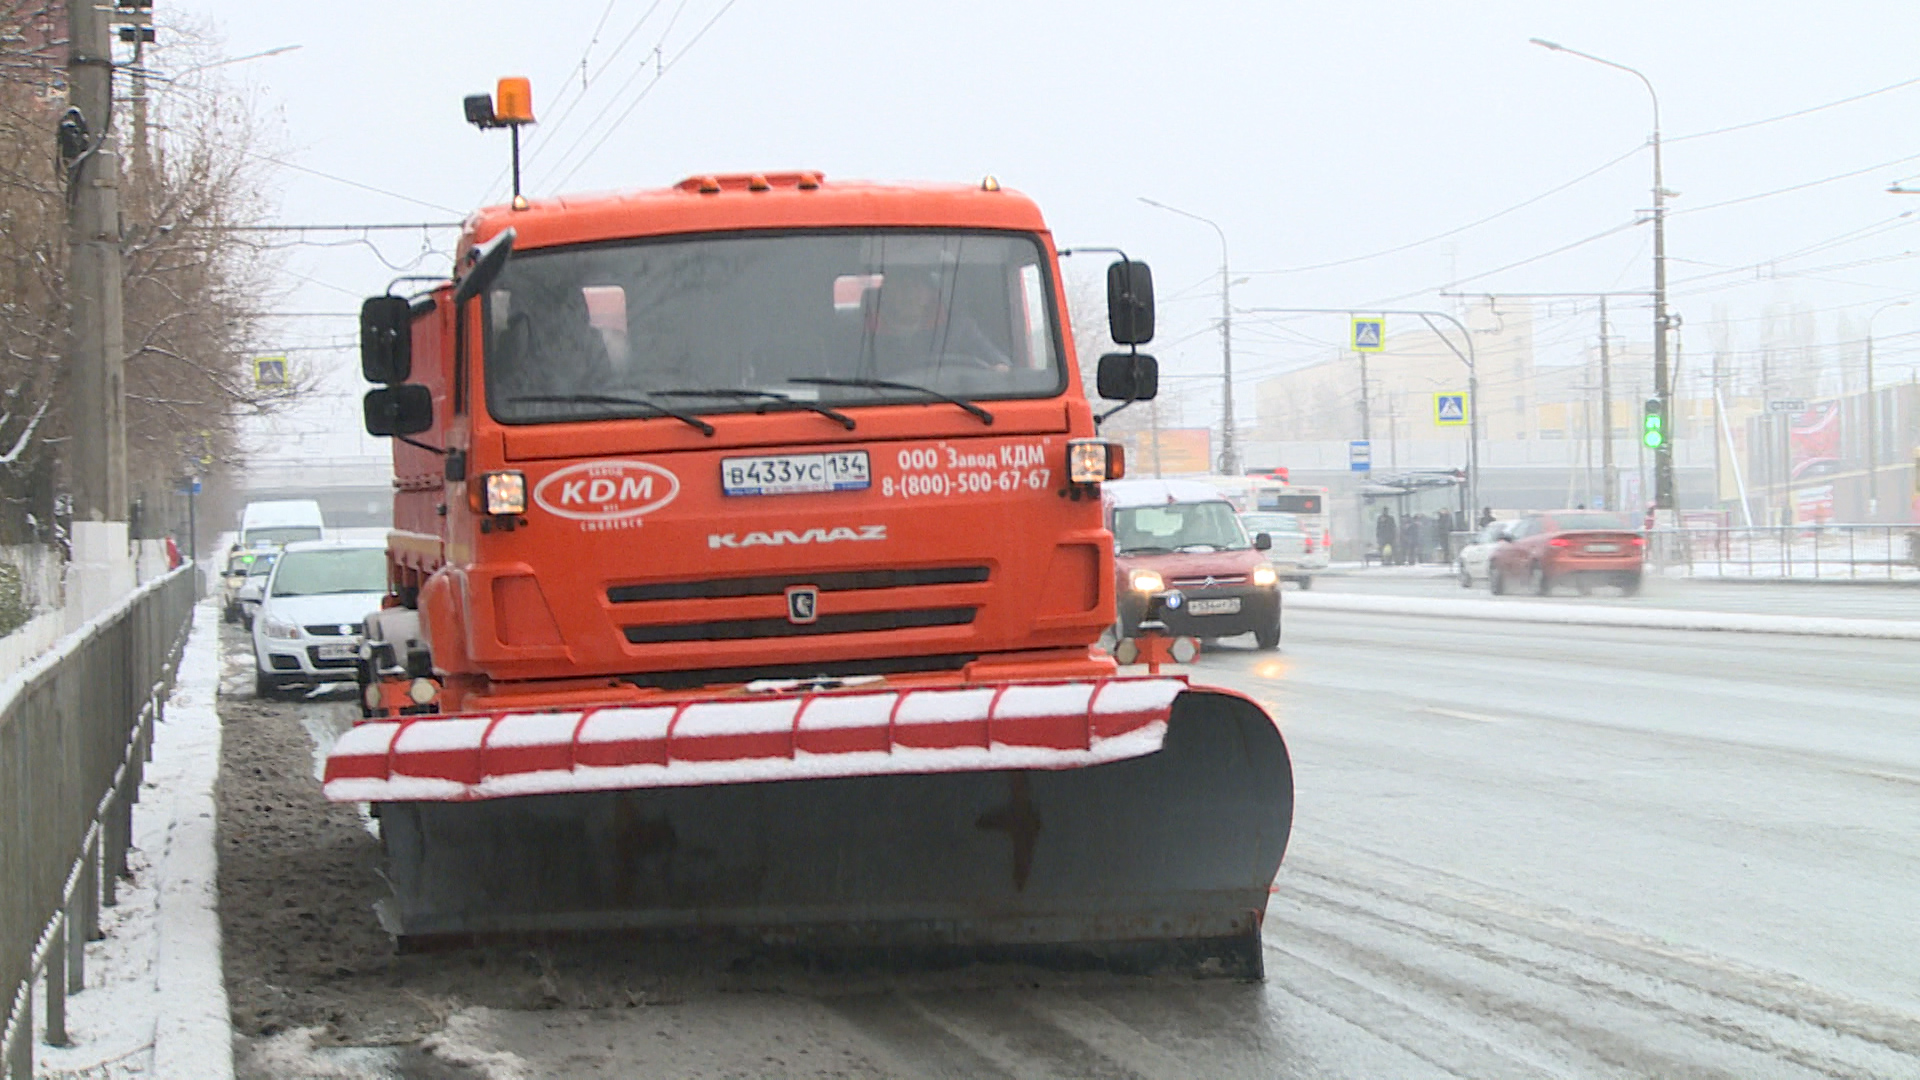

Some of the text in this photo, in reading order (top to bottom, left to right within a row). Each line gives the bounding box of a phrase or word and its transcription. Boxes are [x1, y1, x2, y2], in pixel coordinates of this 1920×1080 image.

[730, 455, 866, 486] В433УС 134
[898, 448, 938, 470] ООО
[560, 475, 654, 505] KDM
[881, 468, 1051, 499] 8-(800)-500-67-67
[708, 525, 888, 549] KAMAZ
